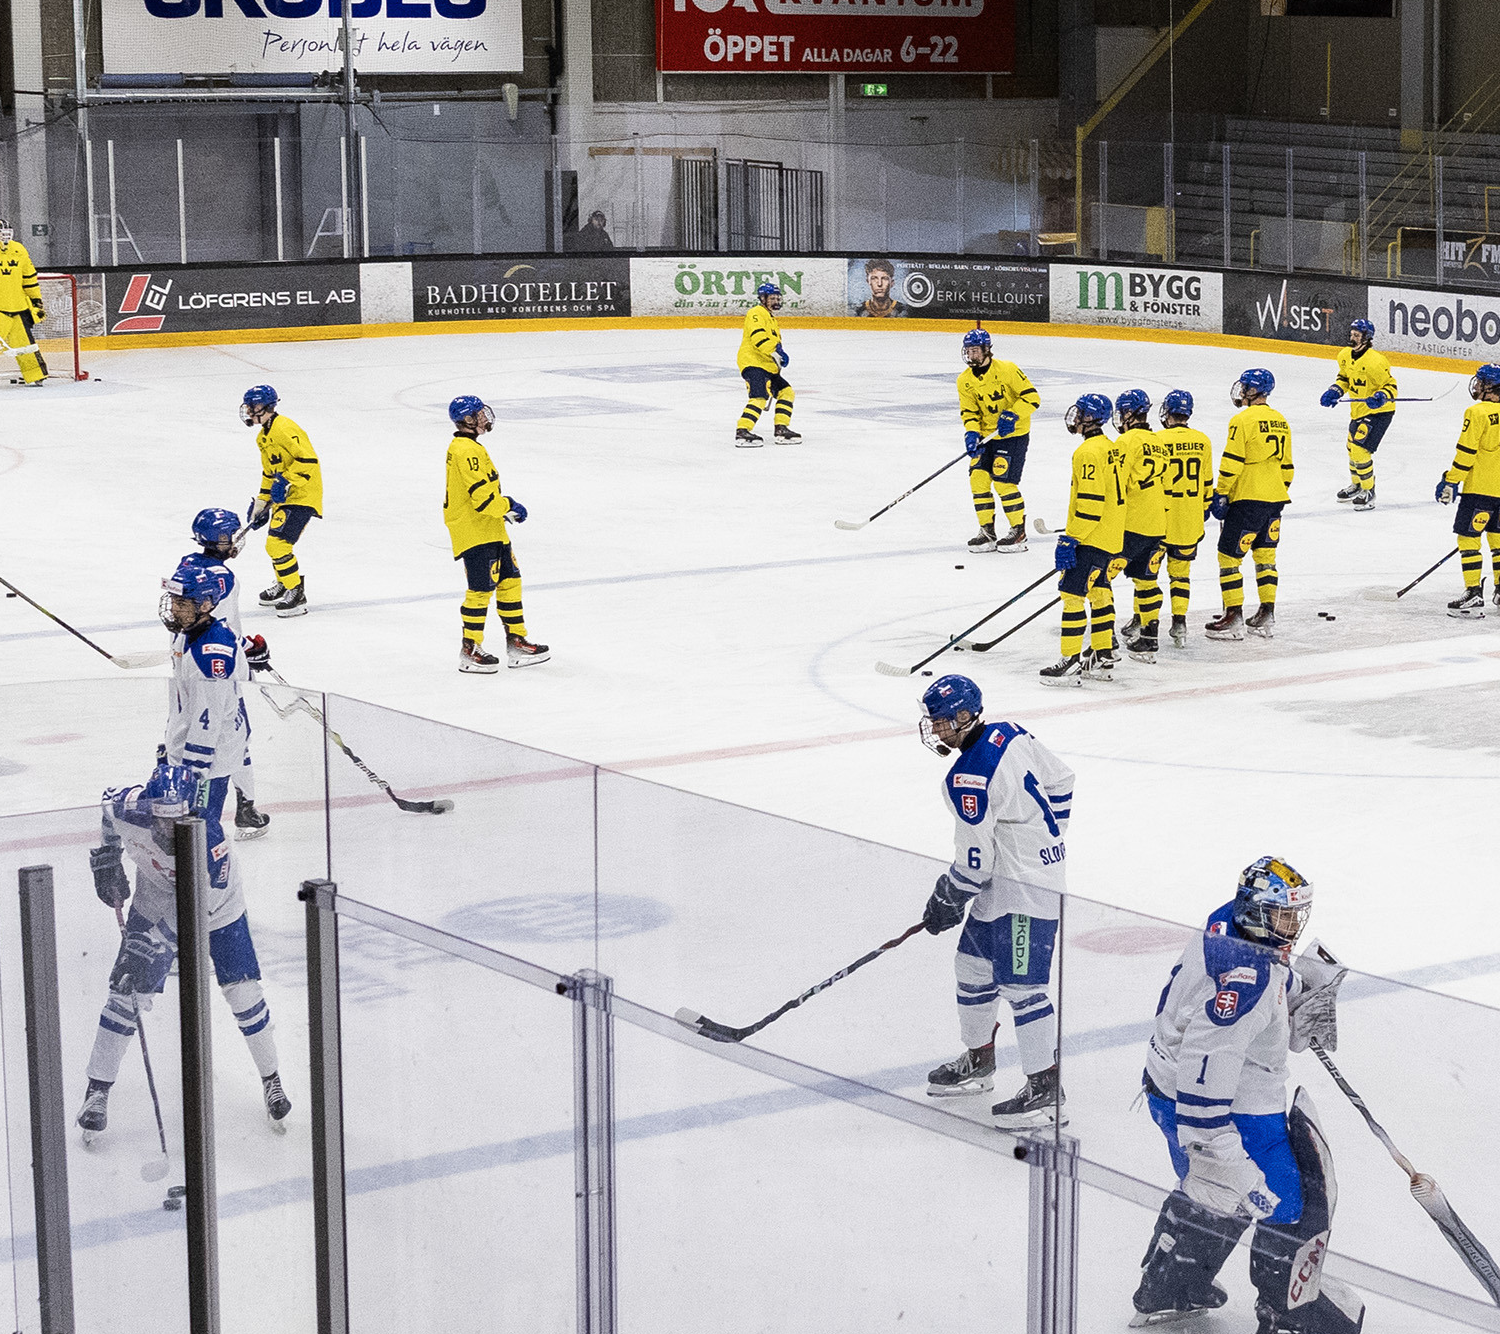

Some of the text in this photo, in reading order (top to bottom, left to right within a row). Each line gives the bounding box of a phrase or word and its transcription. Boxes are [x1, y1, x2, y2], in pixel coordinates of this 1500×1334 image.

[703, 28, 796, 64] ÖPPET
[802, 47, 840, 63] ALLA
[843, 48, 893, 63] DAGAR
[426, 280, 618, 306] BADHOTELLET
[674, 263, 805, 297] ÖRTEN
[1129, 272, 1202, 301] BYGG
[178, 288, 357, 311] LÖFGRENS EL AB
[936, 290, 1044, 305] ERIK HELLQUIST
[1143, 297, 1201, 317] FÖNSTER
[1172, 456, 1201, 498] 29
[966, 846, 982, 871] 6
